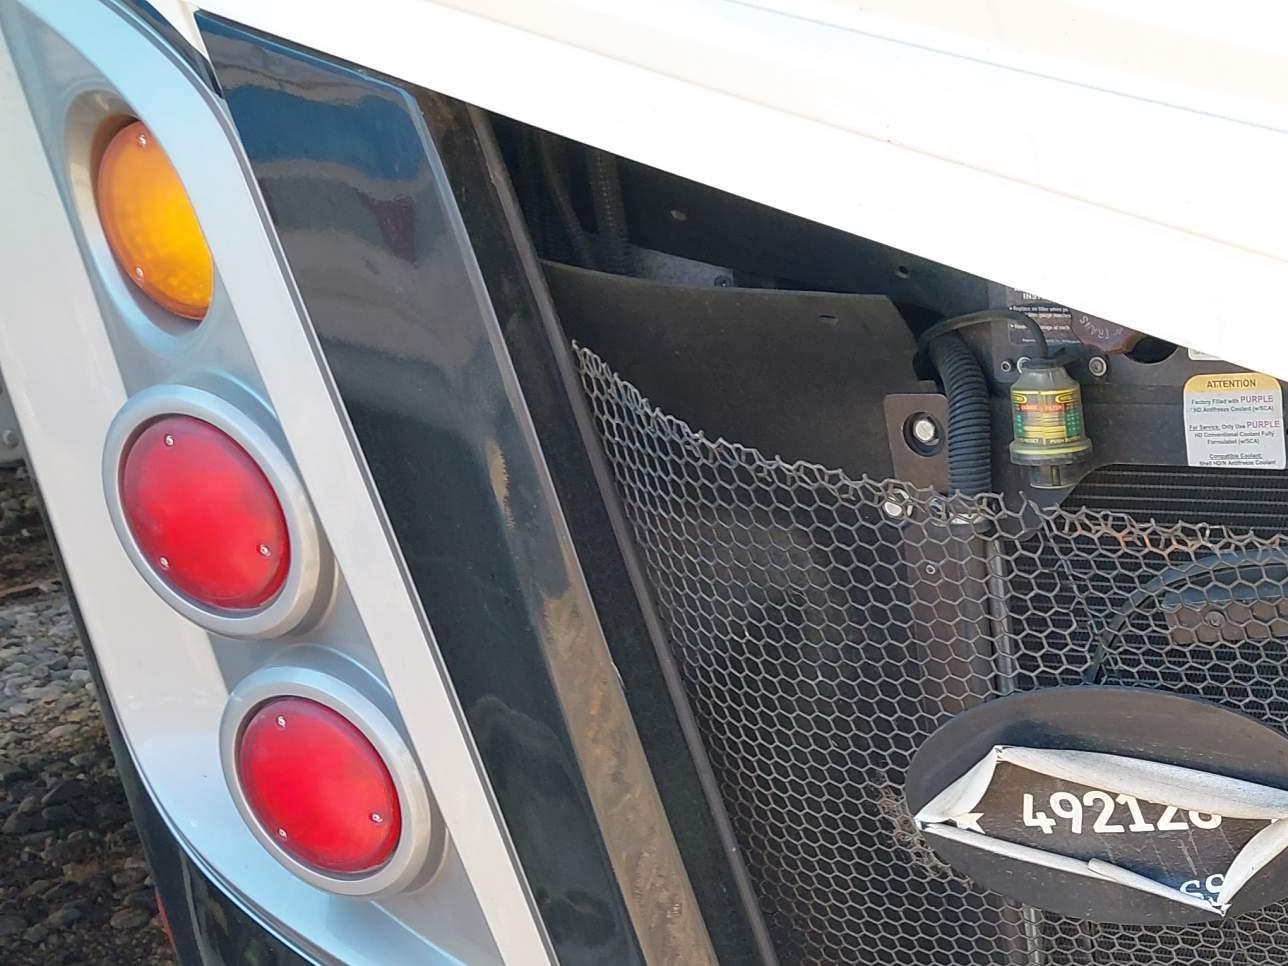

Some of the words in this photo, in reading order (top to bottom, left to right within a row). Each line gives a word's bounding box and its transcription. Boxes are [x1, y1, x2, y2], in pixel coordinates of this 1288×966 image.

[1207, 379, 1256, 388] ATTENTION
[1240, 395, 1273, 403] PURPLE
[1246, 420, 1280, 429] PURPLE
